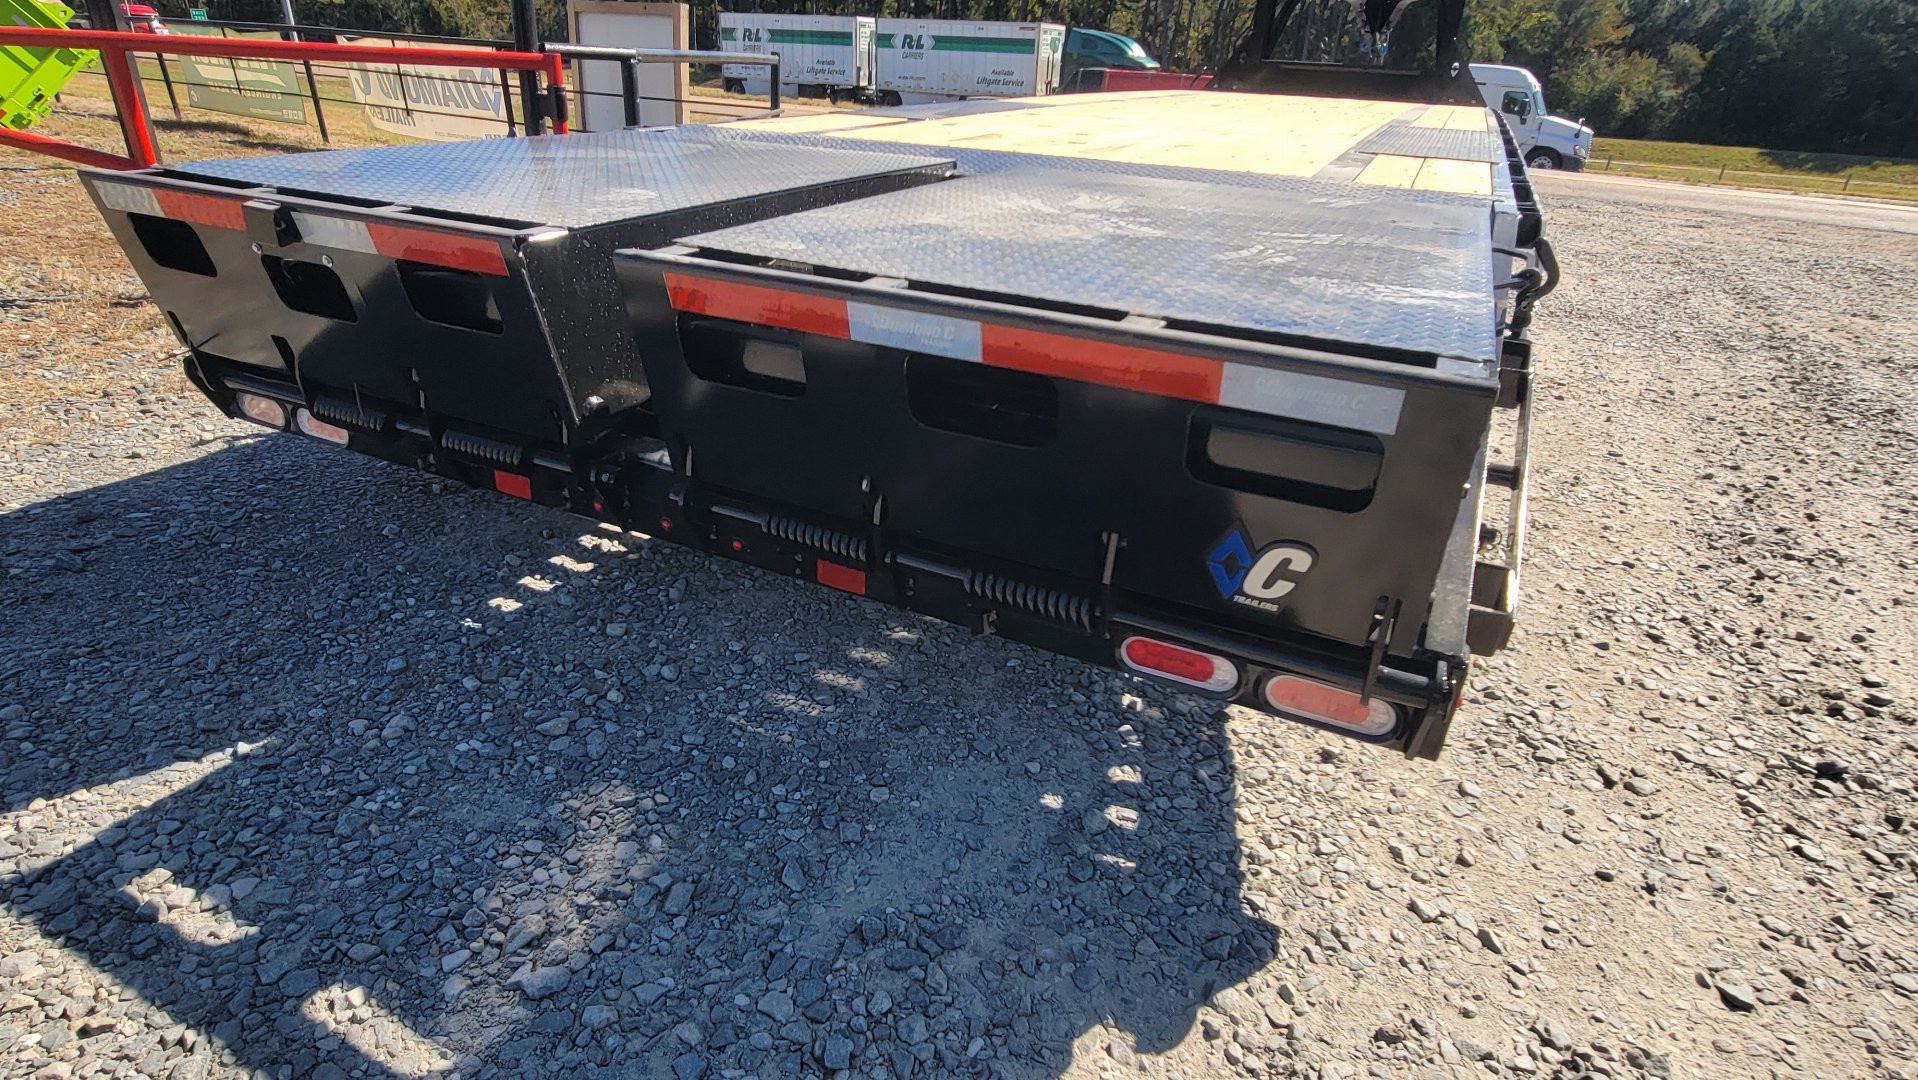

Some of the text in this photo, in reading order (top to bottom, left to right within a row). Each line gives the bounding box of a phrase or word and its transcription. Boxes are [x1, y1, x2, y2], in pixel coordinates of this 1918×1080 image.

[806, 66, 846, 77] Liftgate Service
[990, 68, 1015, 77] Available
[976, 76, 1025, 87] Liftgate Service
[1243, 547, 1313, 599] C
[1233, 594, 1280, 612] TRAILERS
